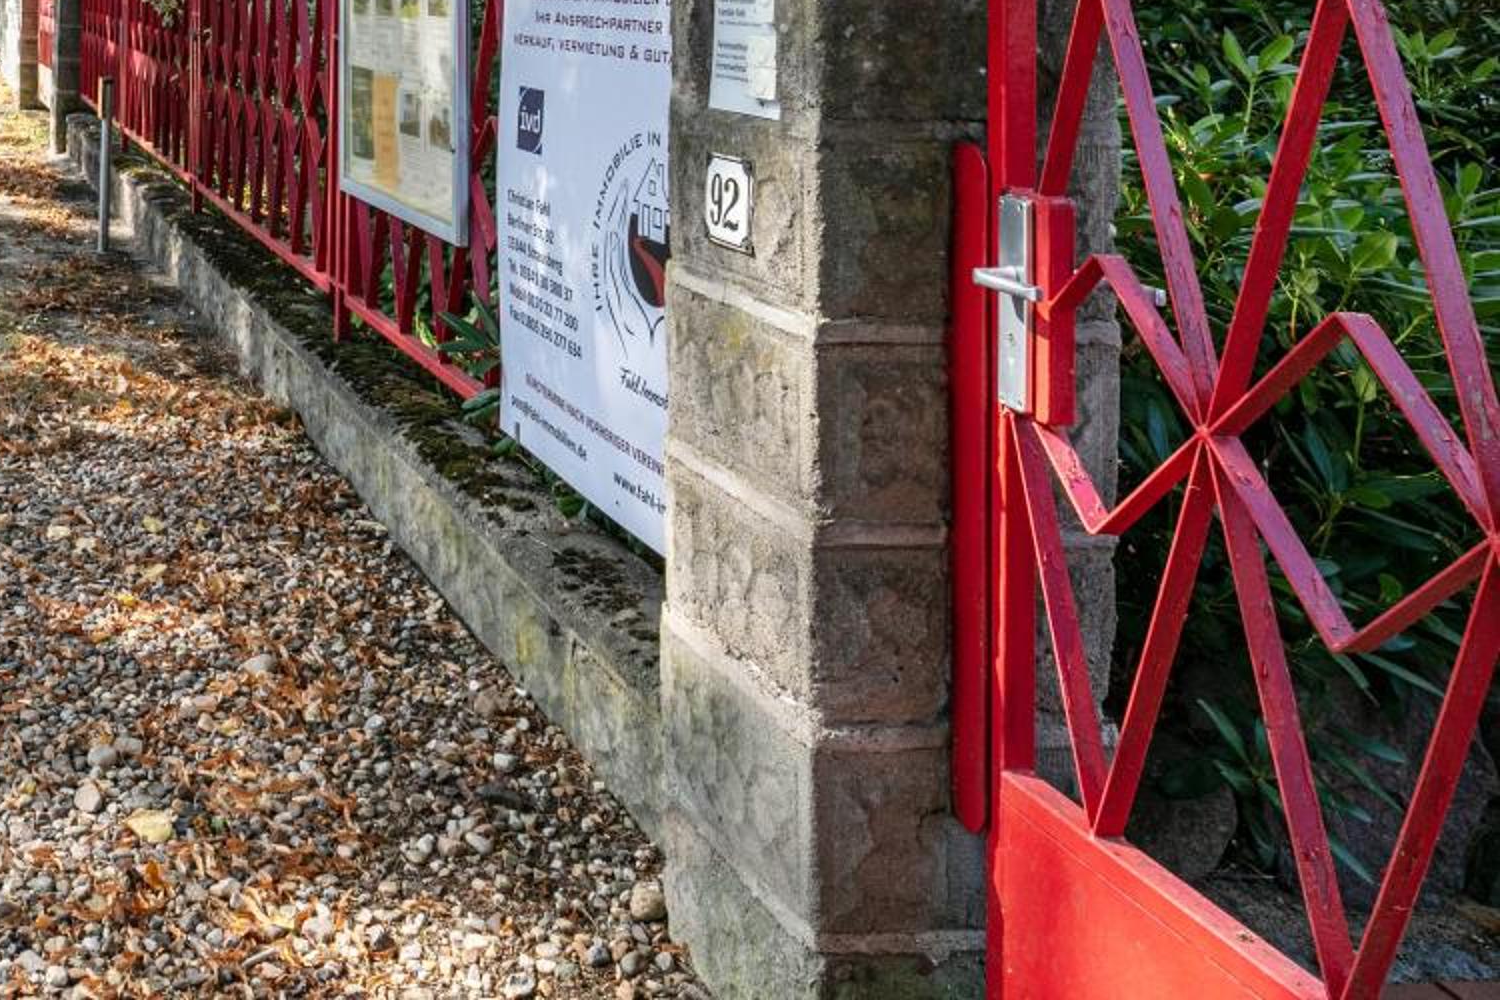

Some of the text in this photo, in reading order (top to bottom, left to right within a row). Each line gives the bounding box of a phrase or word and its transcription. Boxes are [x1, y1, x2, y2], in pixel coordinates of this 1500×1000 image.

[535, 9, 663, 34] IHR ANSPRECHPARTNER
[557, 38, 625, 59] VERMIETUNG
[629, 44, 639, 60] &
[709, 172, 741, 232] 92
